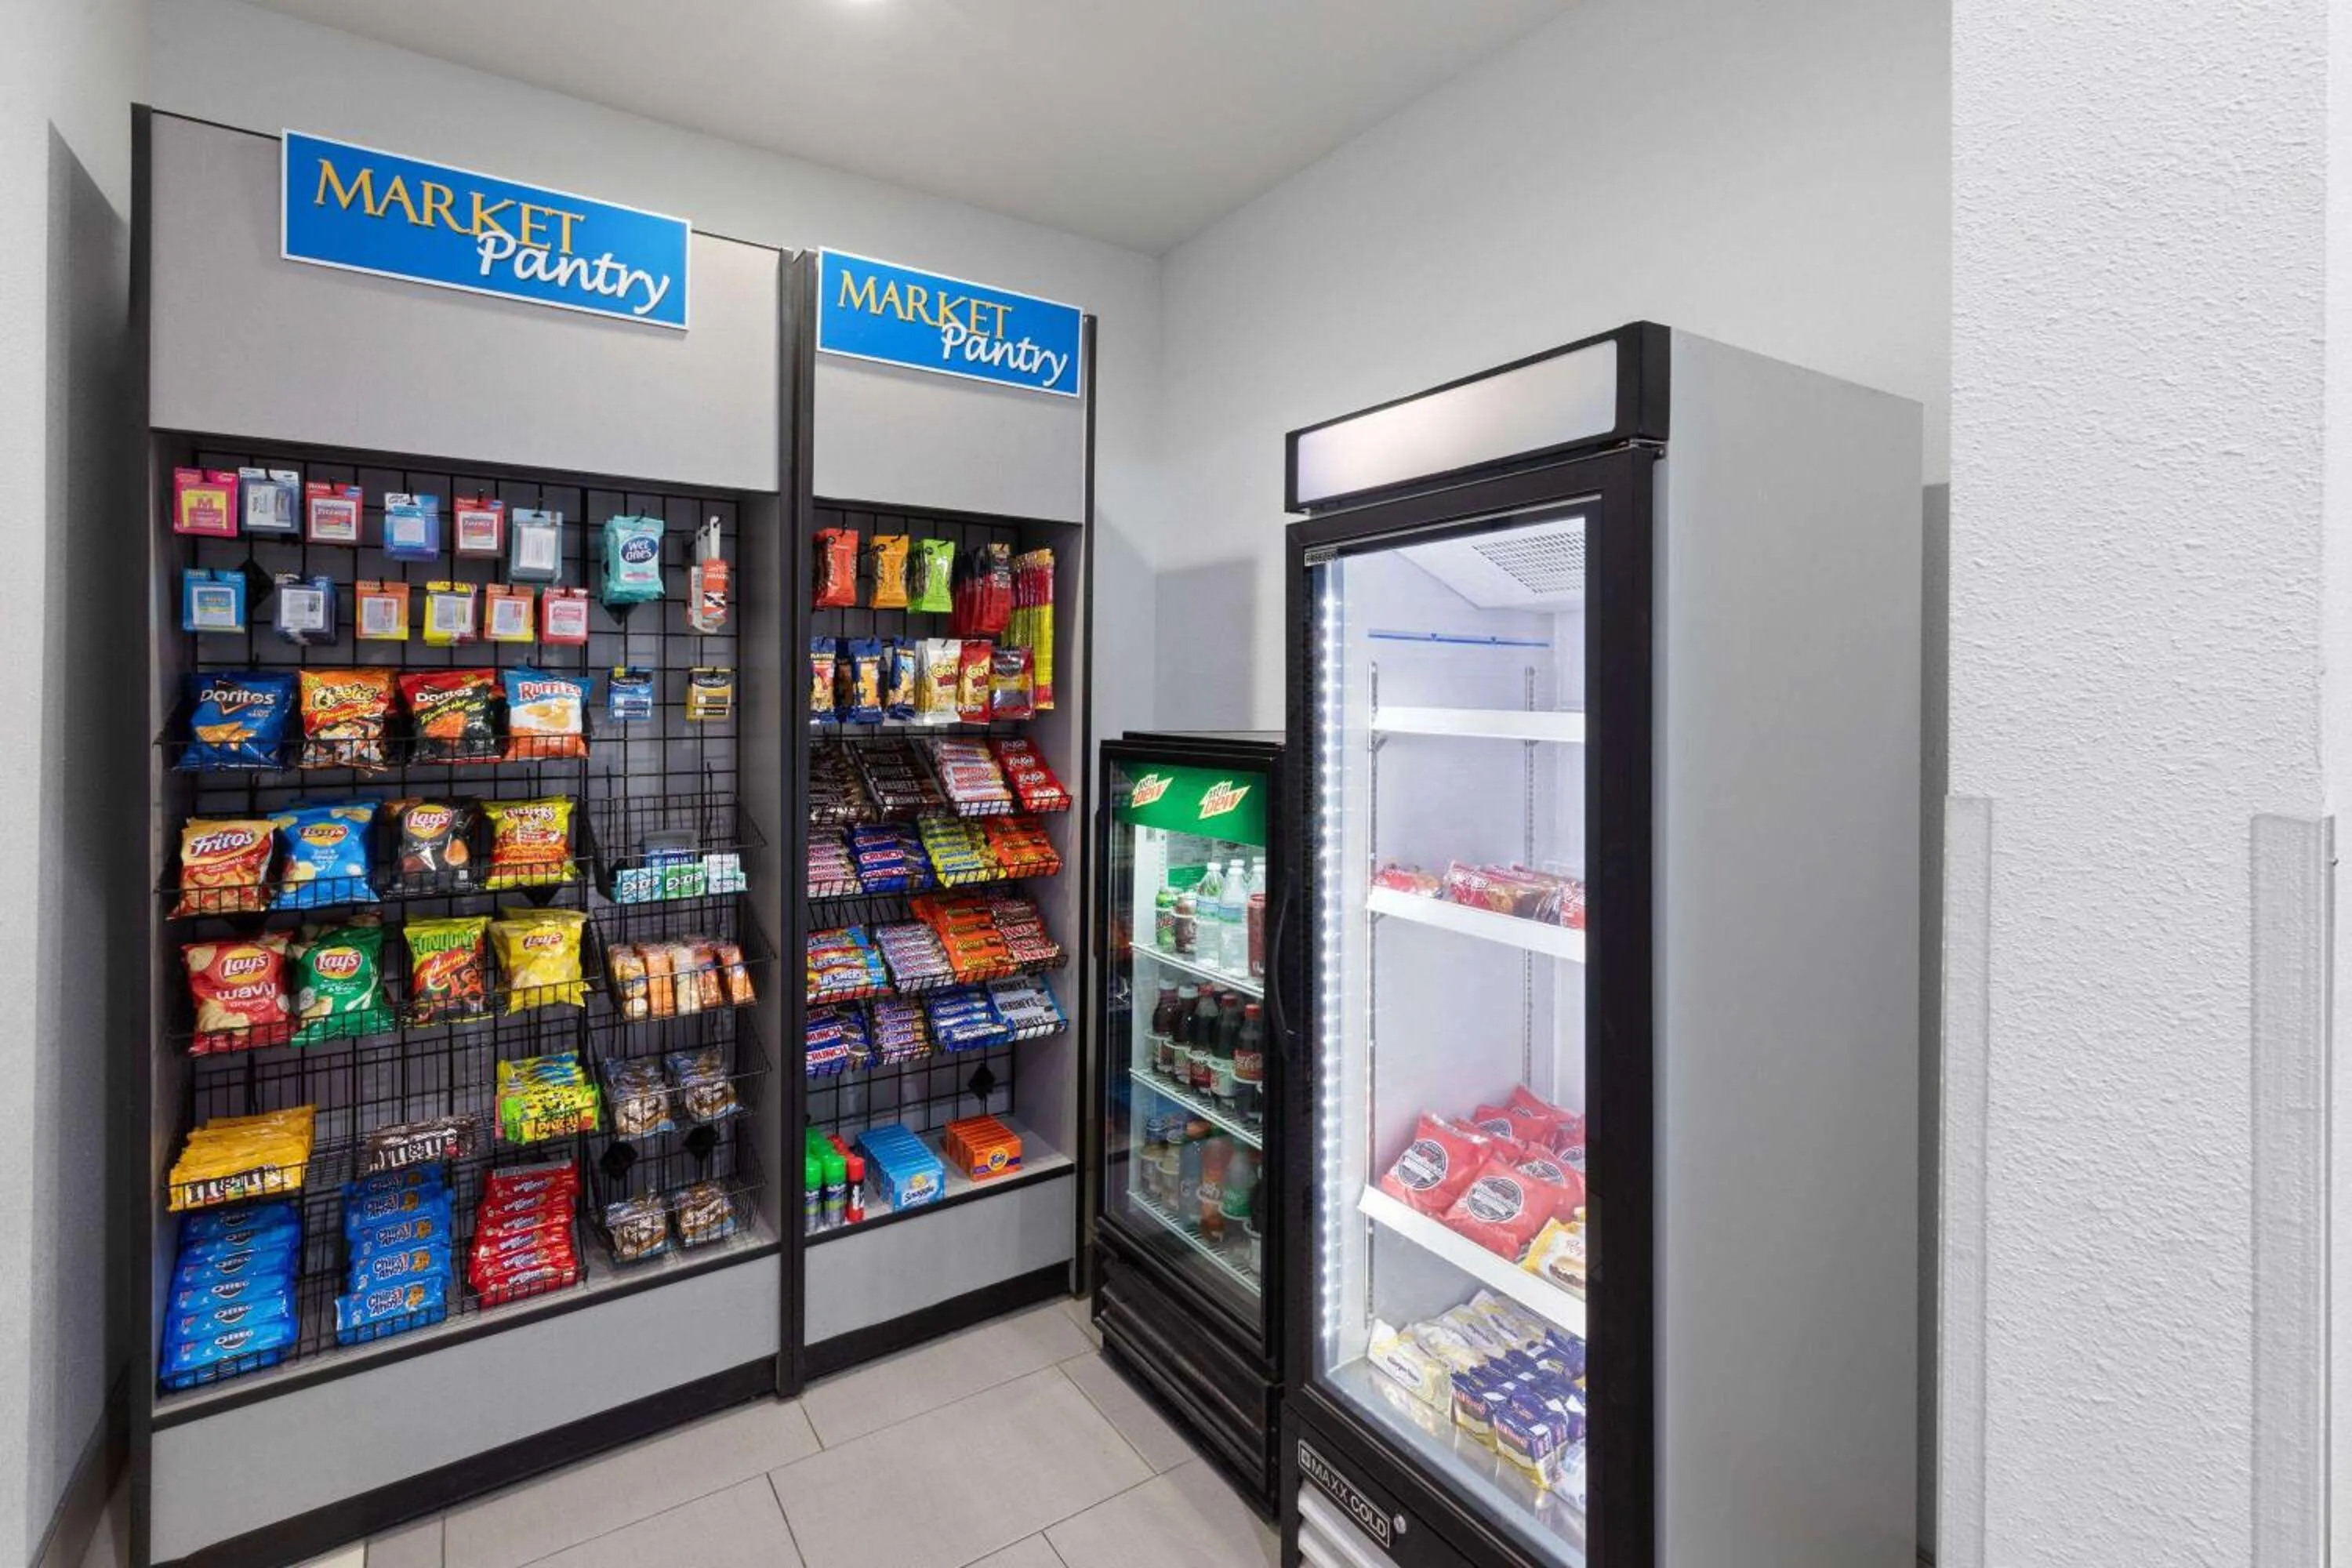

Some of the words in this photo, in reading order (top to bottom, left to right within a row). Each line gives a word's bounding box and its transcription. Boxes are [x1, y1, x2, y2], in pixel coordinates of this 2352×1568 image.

[314, 158, 586, 255] MARKET
[477, 231, 670, 314] Pantry
[837, 270, 1012, 339] MARKET
[941, 323, 1068, 387] Pantry
[201, 688, 276, 706] Doritos
[415, 687, 474, 703] Doritos
[519, 681, 582, 701] RUFFLES
[410, 810, 450, 833] Lay's
[191, 829, 254, 856] Fritos
[862, 851, 904, 862] CRUNCH
[863, 869, 906, 879] CRUNCH
[223, 953, 270, 976] Lay's
[318, 951, 359, 973] Lay's
[1312, 1458, 1348, 1503] MAXX
[1351, 1495, 1386, 1537] COLD
